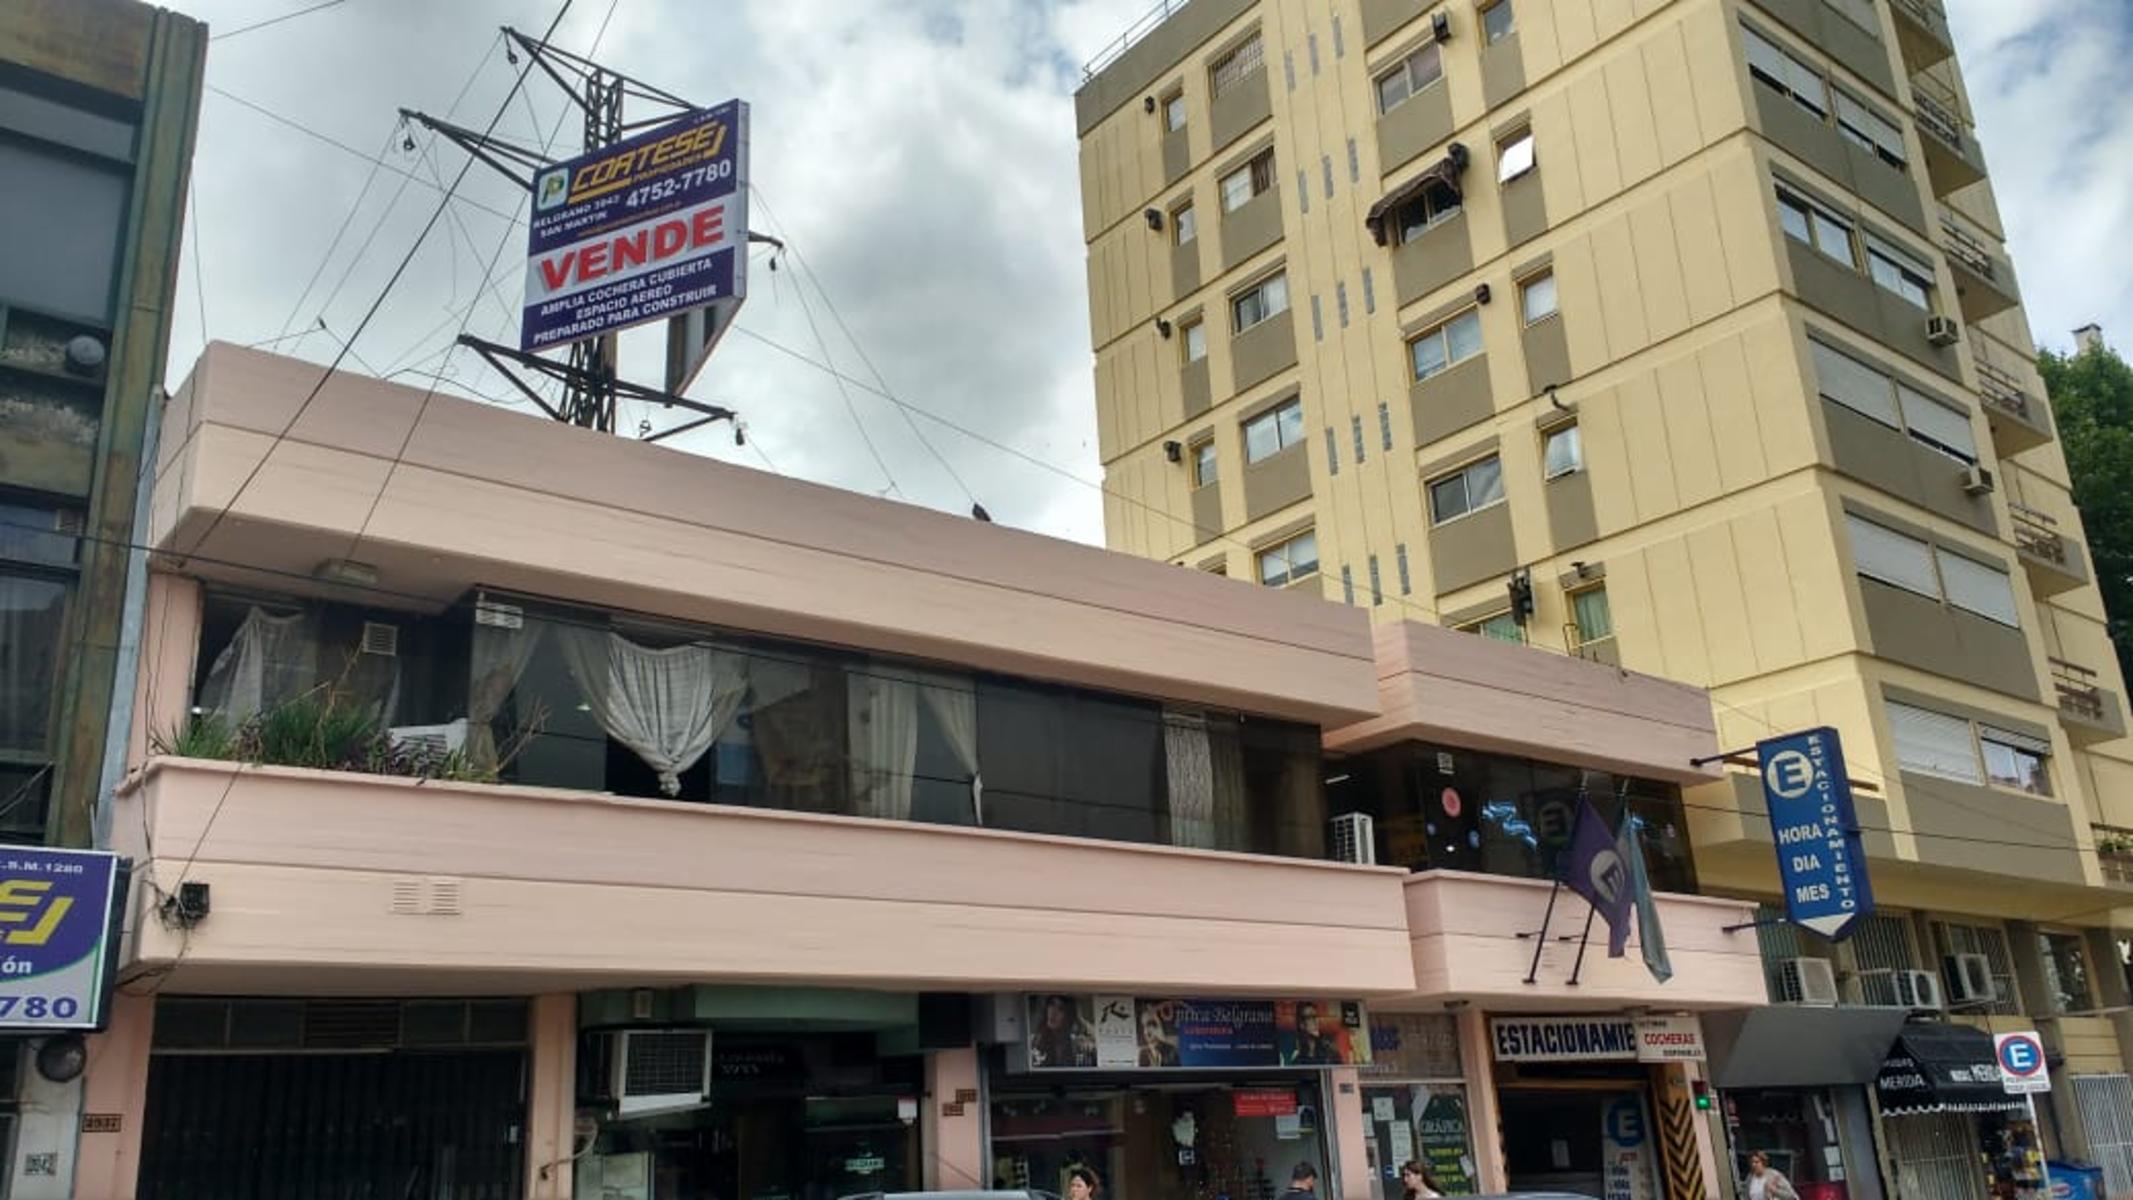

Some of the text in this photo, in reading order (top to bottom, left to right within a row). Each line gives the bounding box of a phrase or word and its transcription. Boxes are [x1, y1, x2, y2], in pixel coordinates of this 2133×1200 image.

[626, 159, 731, 207] 4752-7780
[541, 205, 725, 291] VENDE
[541, 258, 712, 316] AMPLIA COCHERA CUBIERTA
[576, 285, 672, 321] ESPACIO AEREO
[533, 284, 717, 345] PREPARADO PARA CONSTRUIR
[1776, 757, 1806, 792] E
[1778, 823, 1823, 846] HORA
[1808, 735, 1855, 909] ESTACIONAMIENTO
[1793, 855, 1821, 873] DIA
[1796, 883, 1830, 904] MES
[1644, 1033, 1696, 1046] COCHERAS
[2009, 1044, 2032, 1067] E
[1617, 1108, 1639, 1138] E
